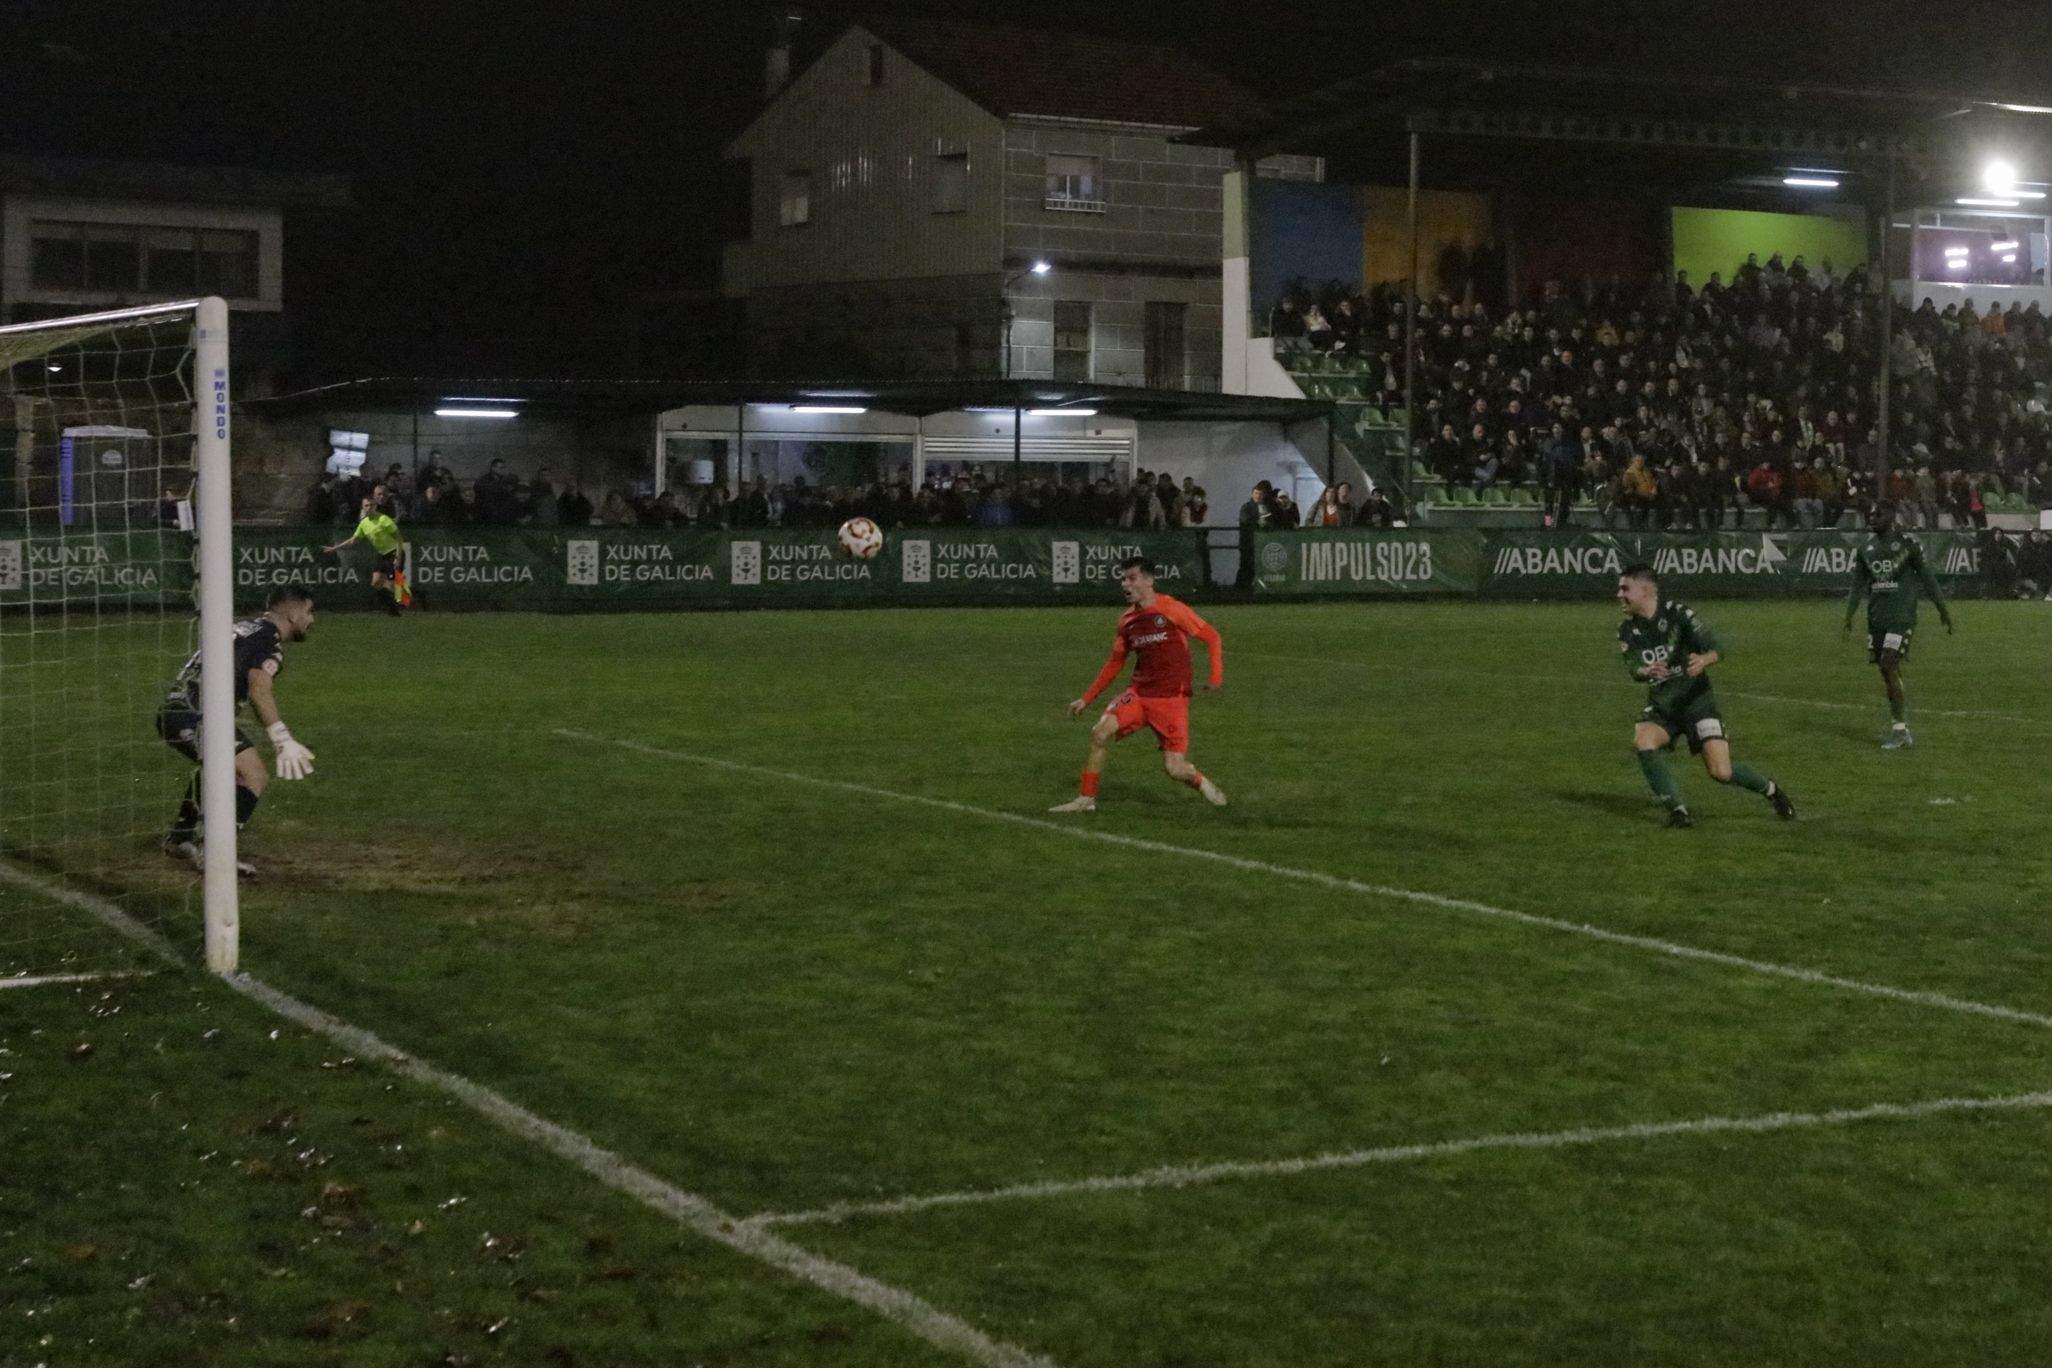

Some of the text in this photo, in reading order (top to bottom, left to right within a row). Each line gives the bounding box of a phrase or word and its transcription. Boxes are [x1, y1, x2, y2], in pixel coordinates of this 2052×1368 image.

[214, 381, 226, 440] MONDO
[31, 546, 109, 563] XUNTA
[239, 546, 314, 563] XUNTA
[418, 546, 490, 562] XUNTA
[606, 544, 673, 561] XUNTA
[768, 544, 832, 561] XUNTA
[937, 543, 998, 560] XUNTA
[1085, 545, 1144, 560] XUNTA
[1301, 541, 1433, 581] IMPULSO23
[31, 567, 158, 586] DE GALICIA
[238, 566, 360, 586] DE GALICIA
[418, 565, 534, 584] DE GALICIA
[604, 563, 714, 581] DE GALICIA
[767, 563, 872, 581] DE GALICIA
[936, 562, 1036, 580] DE GALICIA
[1085, 564, 1181, 580] DE GCIA
